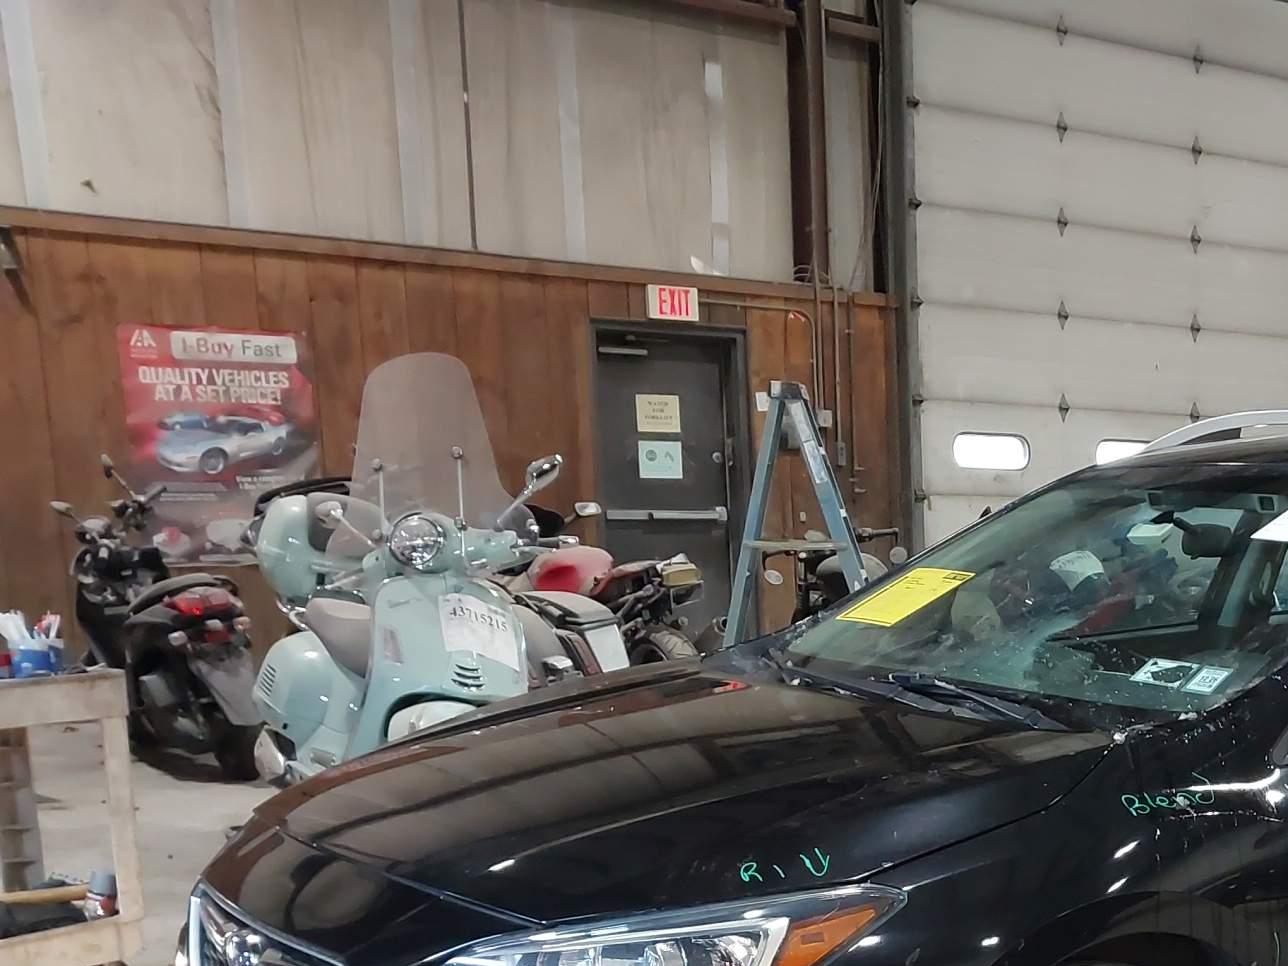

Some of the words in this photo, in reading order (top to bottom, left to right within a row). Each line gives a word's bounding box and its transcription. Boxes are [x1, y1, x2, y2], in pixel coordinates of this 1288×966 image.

[657, 287, 691, 317] EXIT
[181, 337, 235, 360] I-Buy
[241, 339, 282, 358] Fast
[138, 366, 209, 385] QUALITY
[212, 368, 290, 388] VEHICLES
[155, 385, 176, 401] AT
[180, 386, 193, 402] A
[195, 386, 225, 403] SET
[229, 387, 283, 405] PRICE!
[449, 606, 508, 632] 43715215
[1121, 771, 1215, 817] Blend
